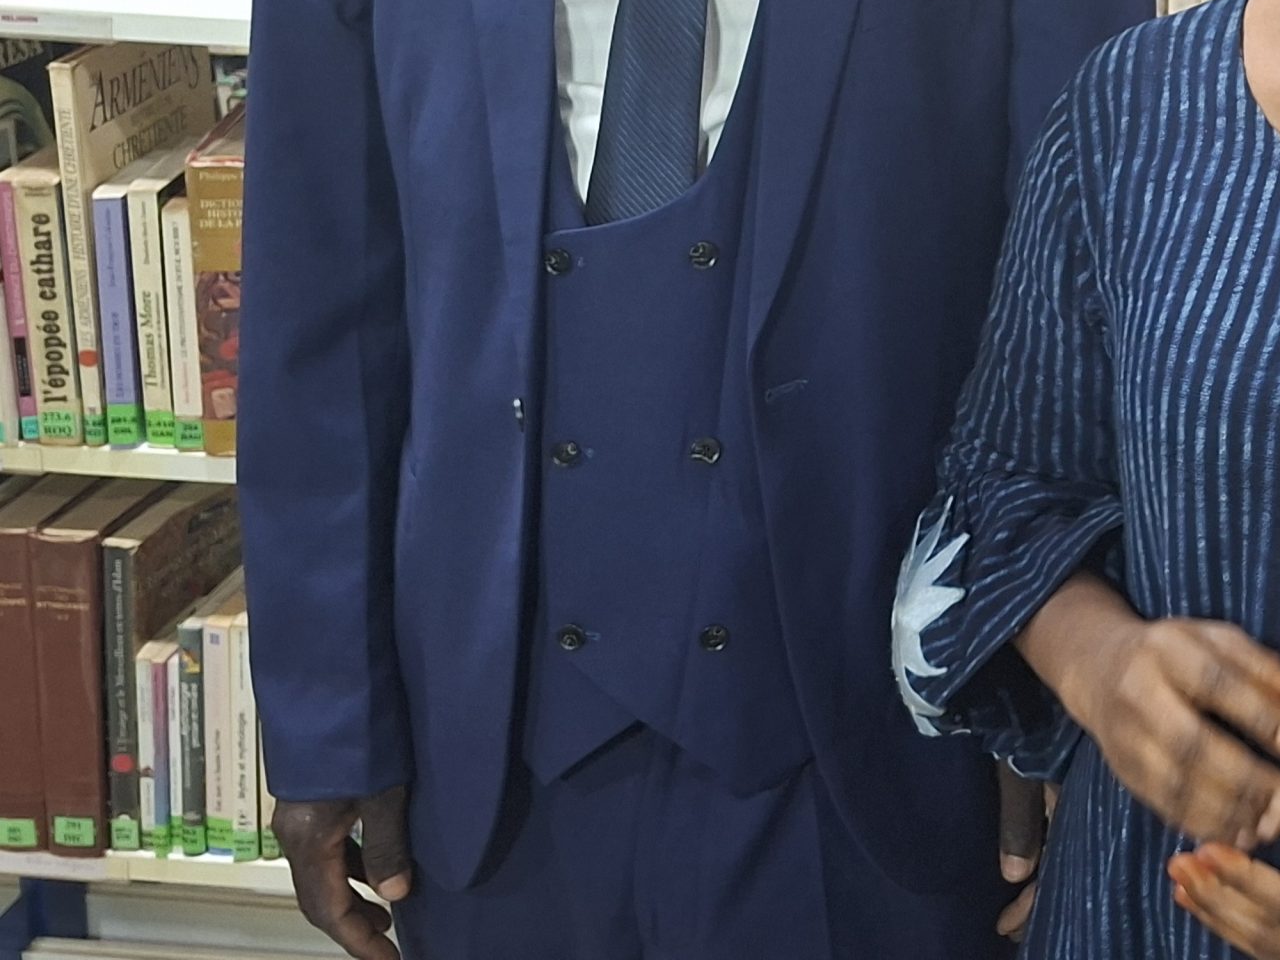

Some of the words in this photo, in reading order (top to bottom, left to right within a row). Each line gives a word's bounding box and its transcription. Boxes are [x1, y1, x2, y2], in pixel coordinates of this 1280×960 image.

[30, 213, 58, 301] cathare
[138, 291, 153, 328] More
[36, 309, 69, 404] l'épopée
[143, 332, 158, 390] Thomas
